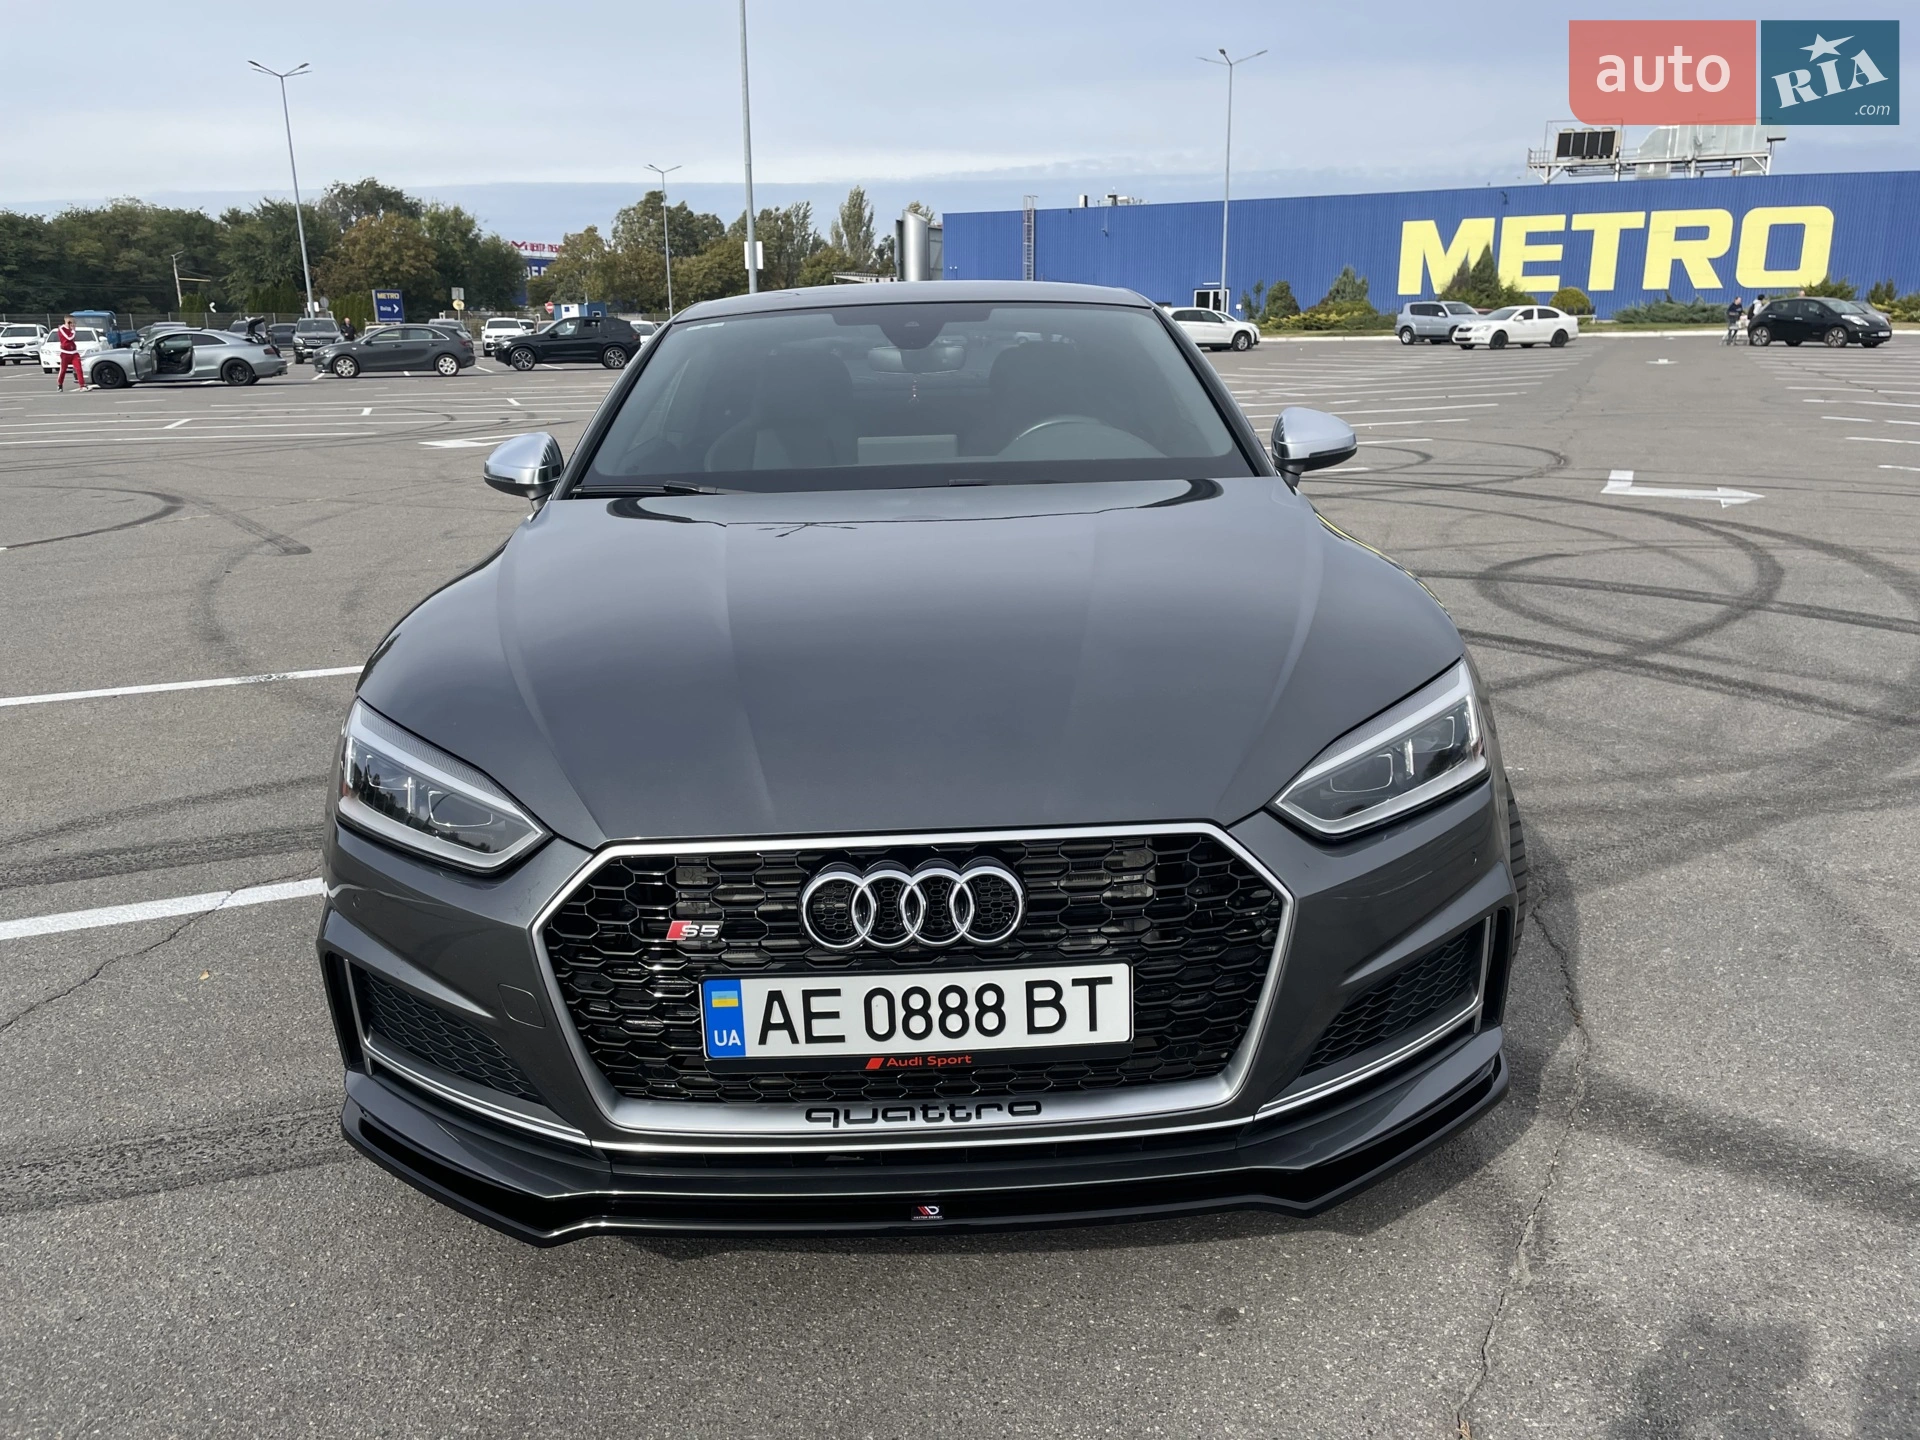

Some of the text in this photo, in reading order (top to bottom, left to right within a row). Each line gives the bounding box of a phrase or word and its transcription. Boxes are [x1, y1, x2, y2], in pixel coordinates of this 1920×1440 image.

[1398, 205, 1834, 296] METRO
[680, 924, 720, 938] S5
[757, 976, 1113, 1045] AE 0888 BT
[714, 1029, 742, 1047] UA
[886, 1054, 973, 1068] Audi Sport
[805, 1101, 1042, 1128] quattro
